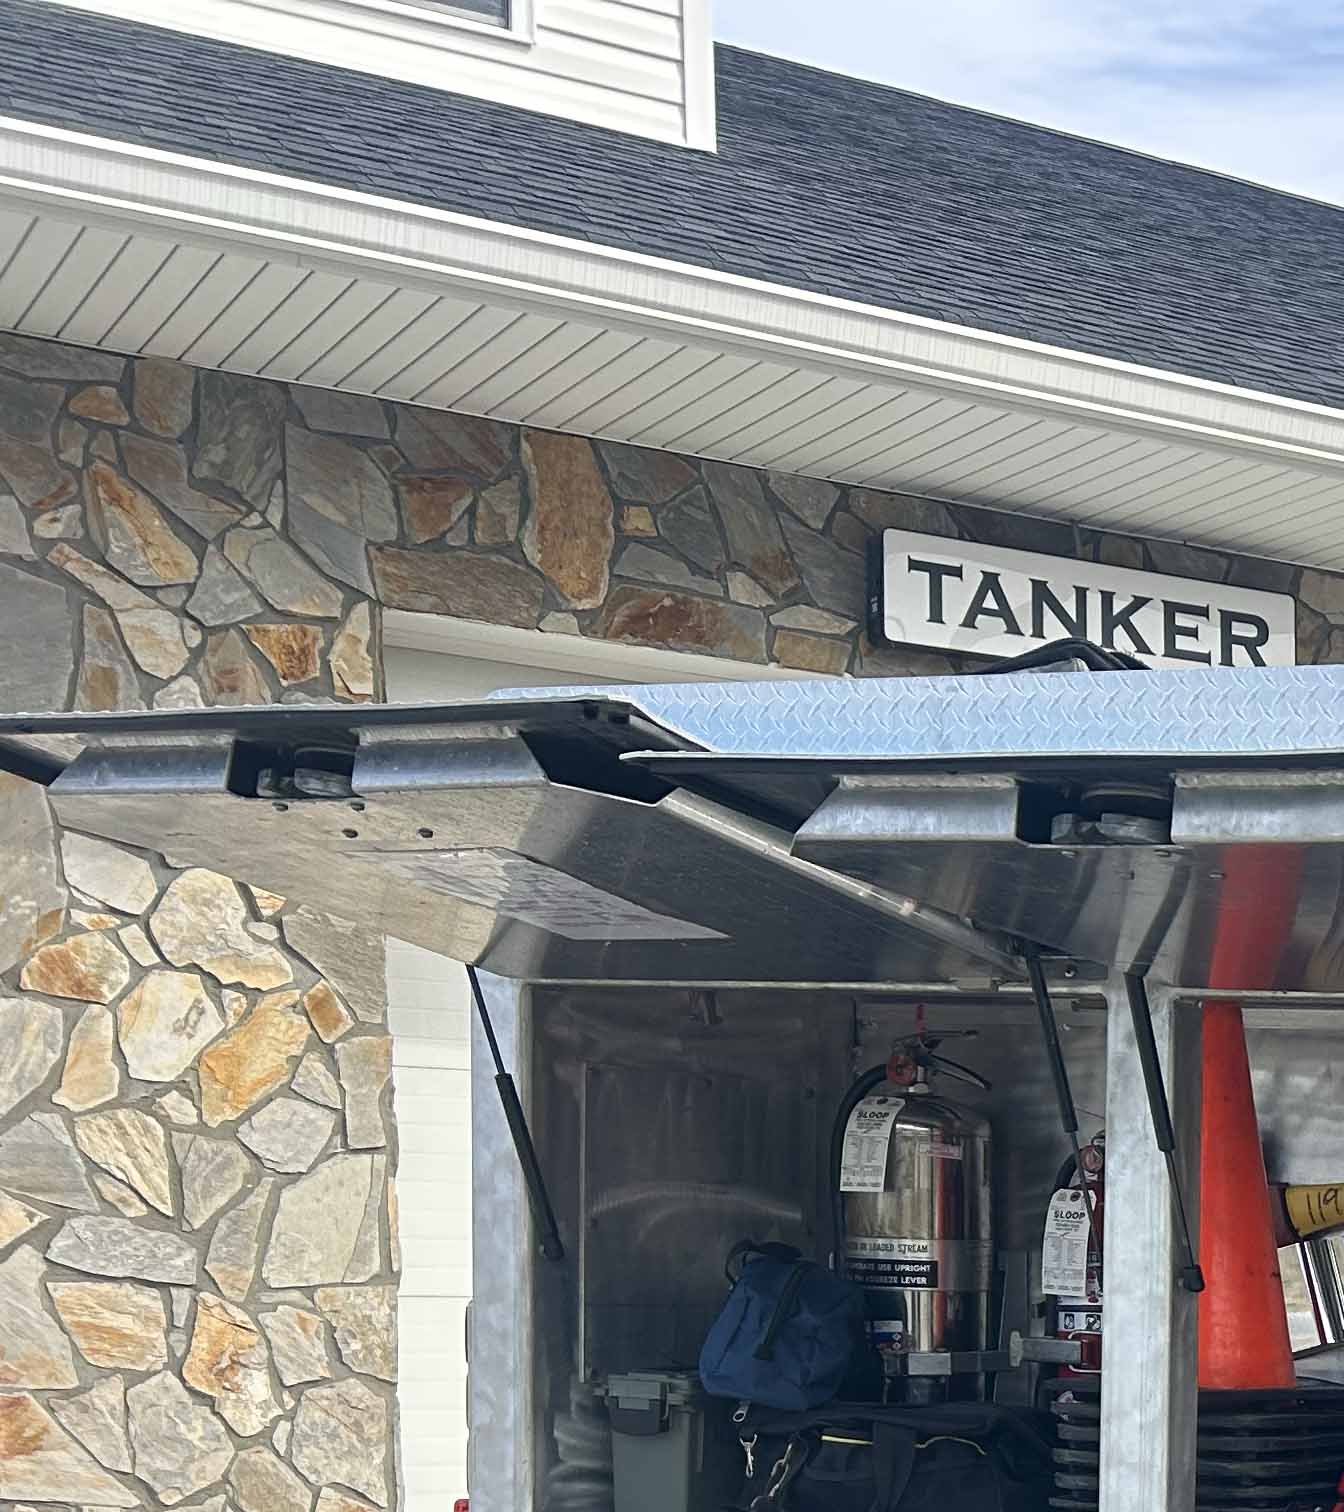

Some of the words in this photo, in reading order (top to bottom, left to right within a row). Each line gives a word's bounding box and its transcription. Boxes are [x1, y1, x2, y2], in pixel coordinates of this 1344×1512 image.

[907, 555, 1271, 667] TANKER
[857, 1111, 889, 1119] SLOOP
[1053, 1210, 1086, 1220] SLOOP
[897, 1243, 929, 1254] STREAM
[894, 1264, 931, 1273] UPRIGHT
[900, 1276, 928, 1285] LEVER
